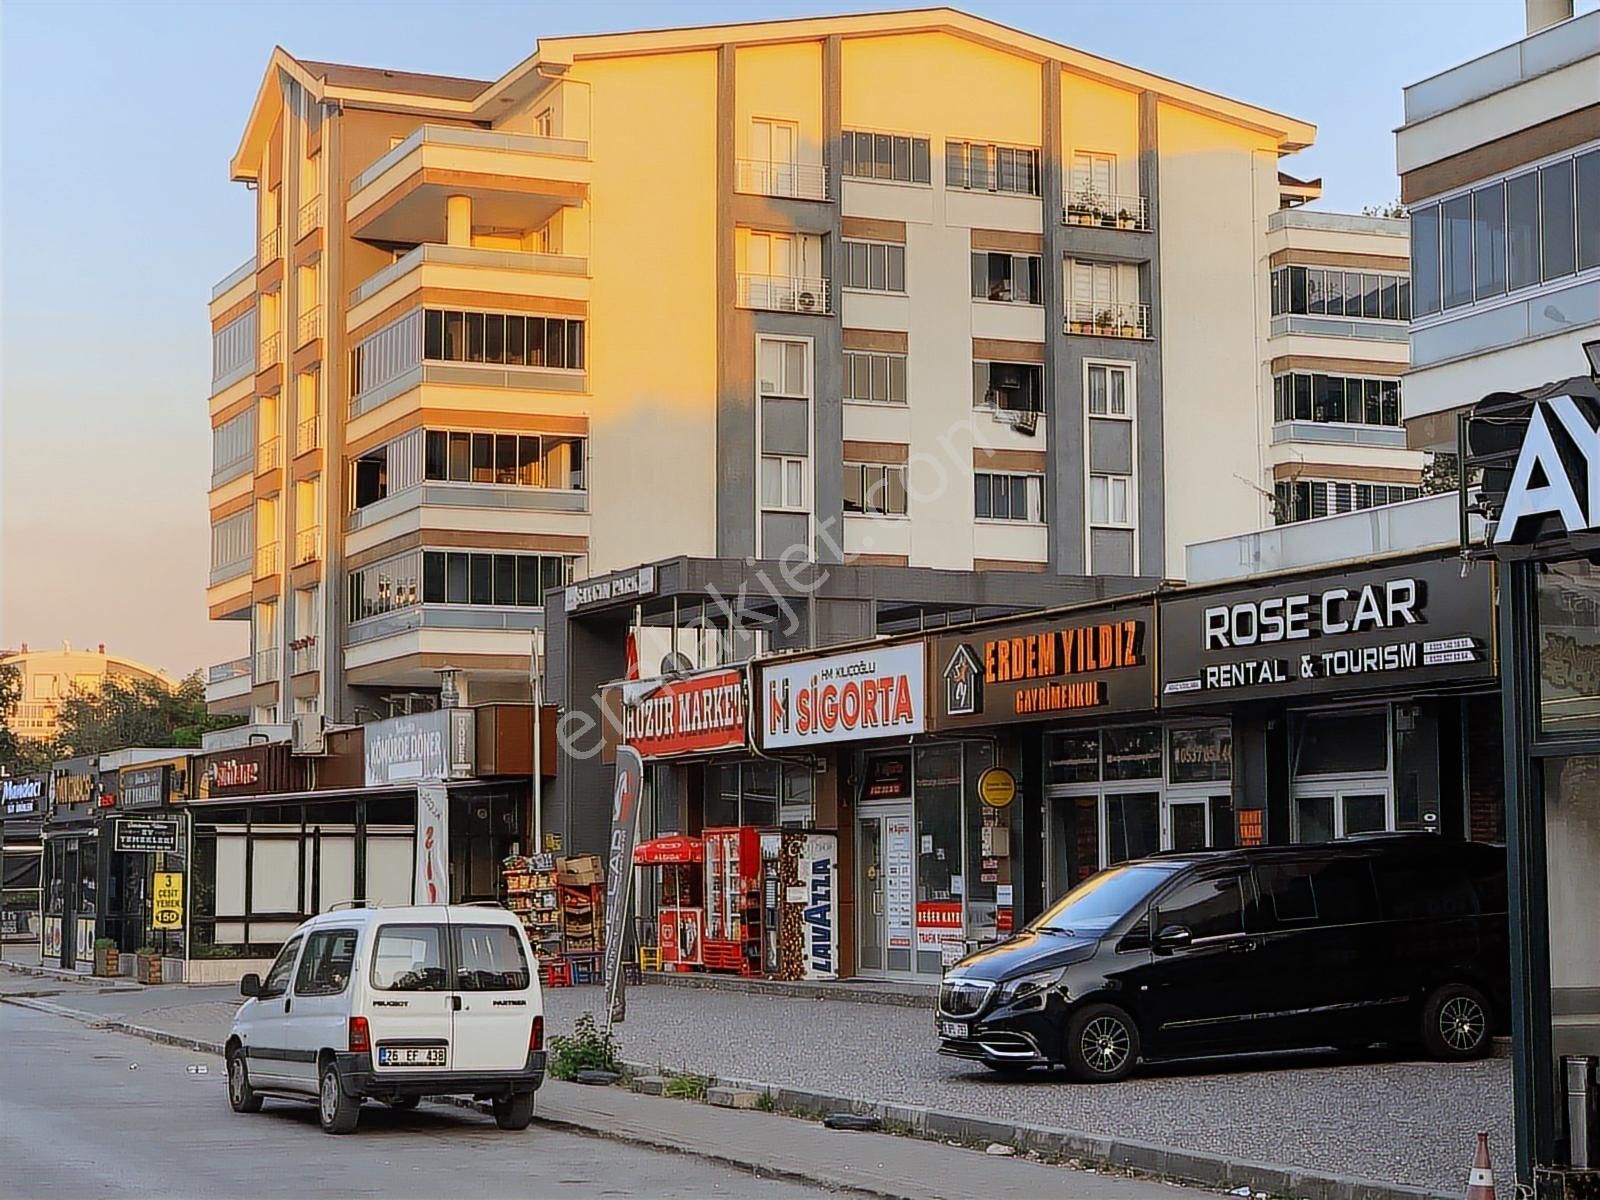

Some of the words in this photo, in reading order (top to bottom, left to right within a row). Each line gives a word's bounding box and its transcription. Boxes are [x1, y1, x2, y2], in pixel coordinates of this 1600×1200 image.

[612, 575, 638, 597] PARK
[1205, 595, 1310, 650] ROSE
[1321, 579, 1416, 634] CAR
[985, 631, 1055, 683] ERDEM
[1061, 620, 1136, 675] YILDIZ
[1206, 659, 1286, 689] RENTAL
[1301, 656, 1313, 678] &
[1322, 642, 1416, 677] TOURISM
[796, 675, 913, 736] SİGORTA
[165, 875, 172, 887] 3
[156, 899, 180, 908] YEMEK
[158, 911, 177, 921] 150
[804, 858, 832, 973] LAVAZZA
[406, 1050, 419, 1061] EF
[426, 1050, 444, 1061] 438
